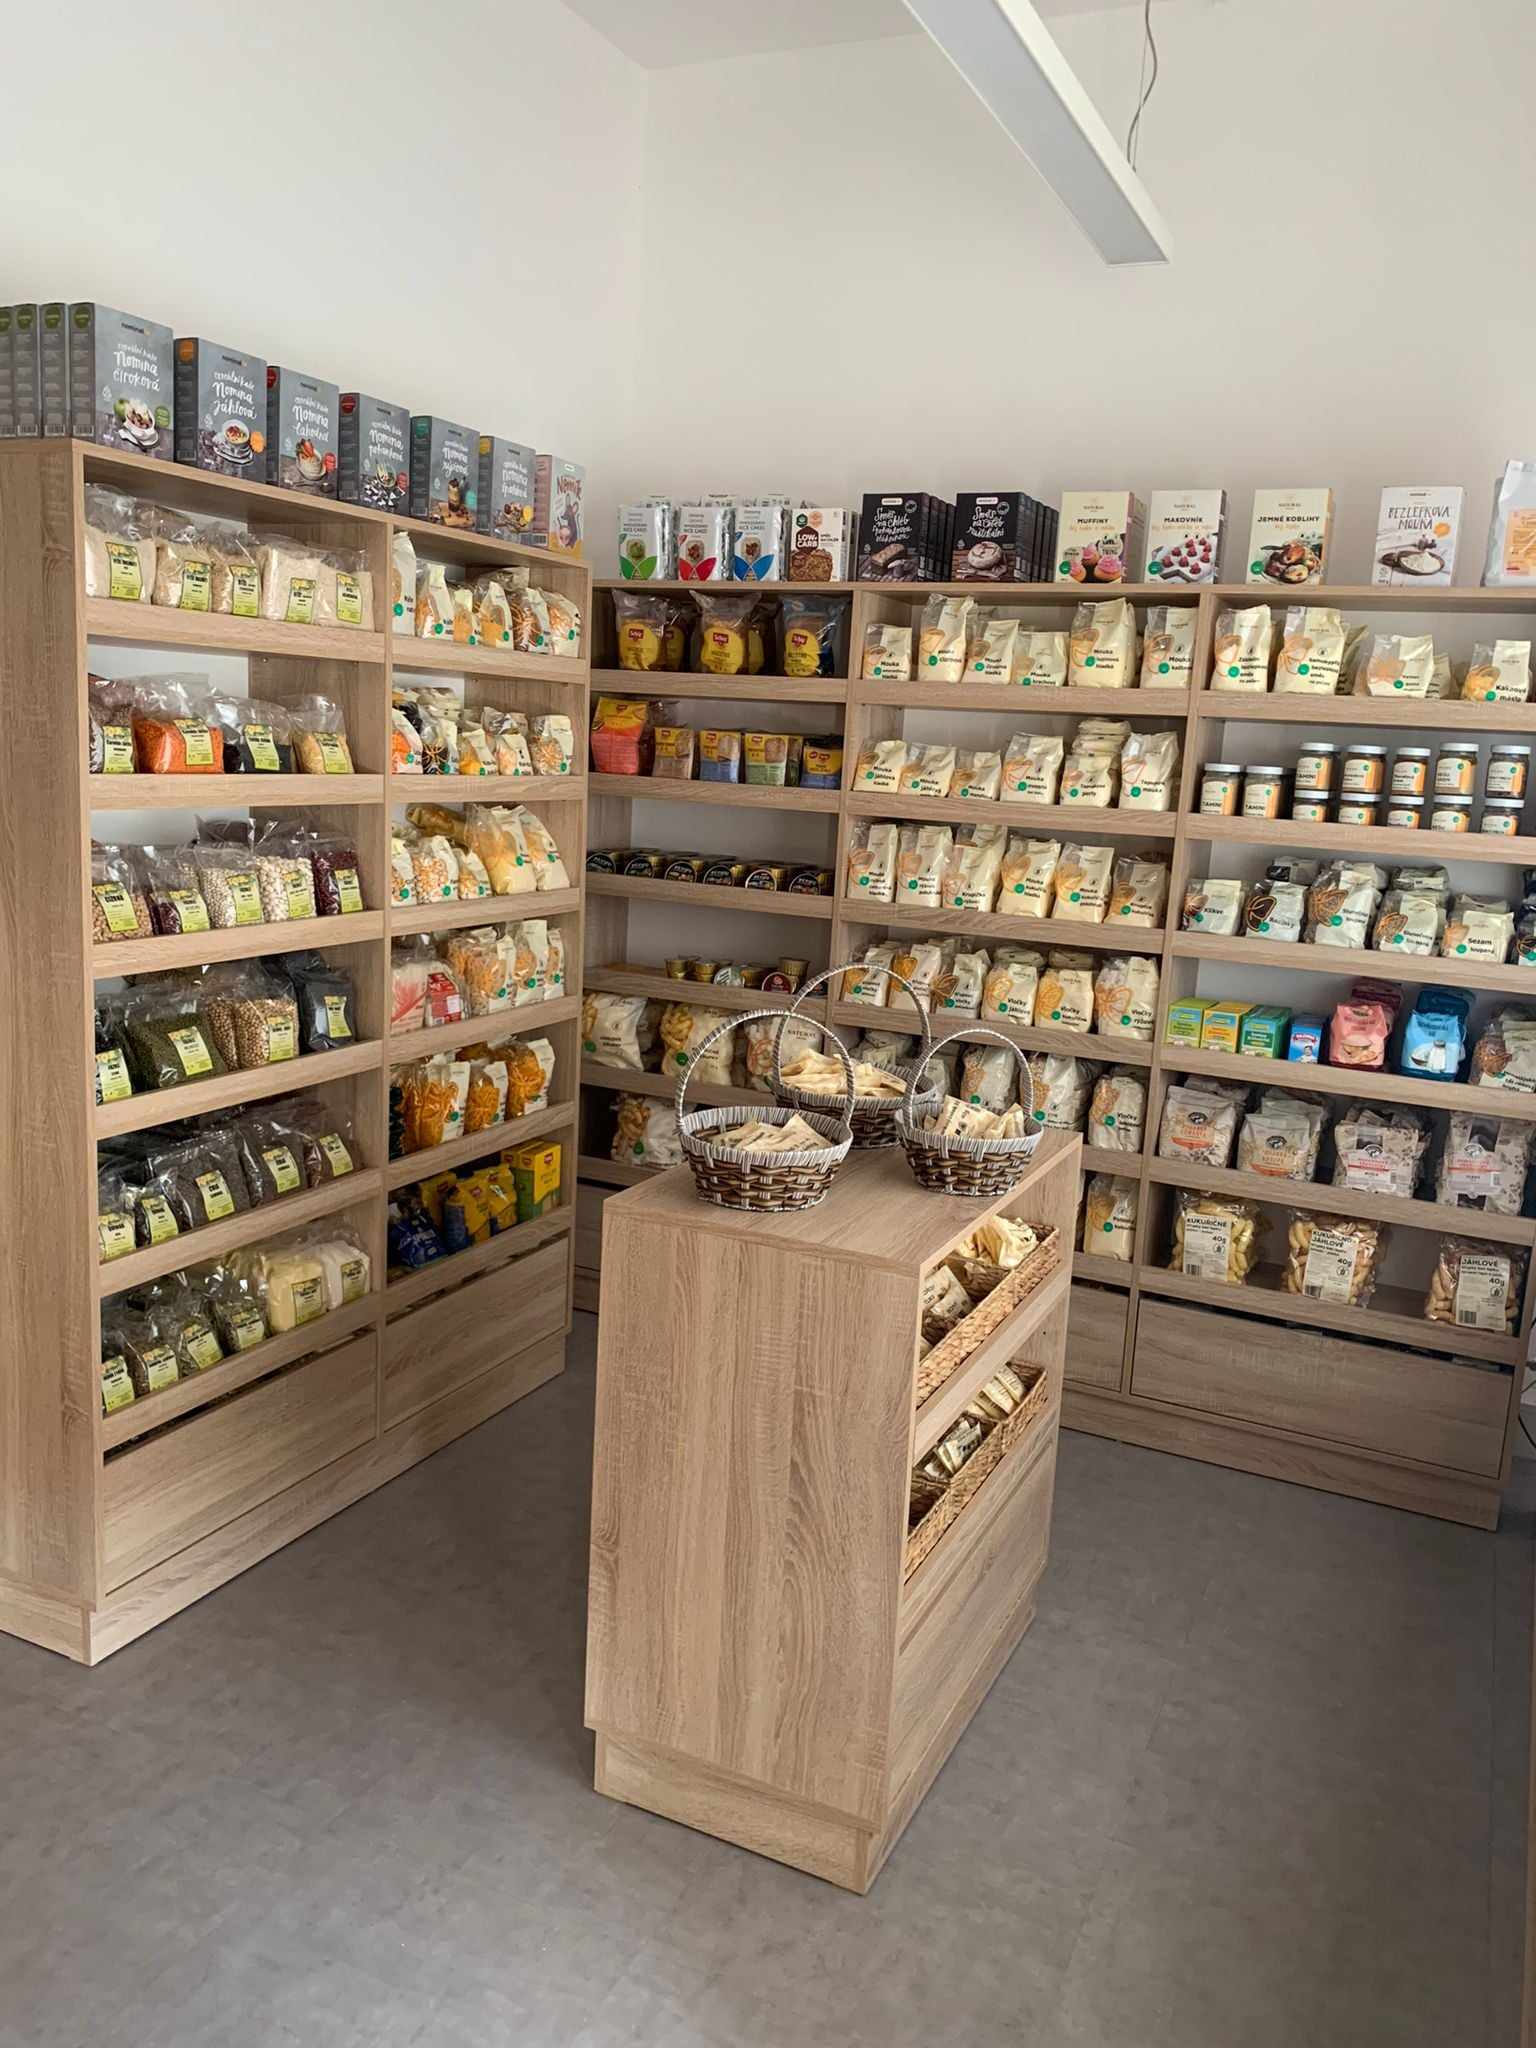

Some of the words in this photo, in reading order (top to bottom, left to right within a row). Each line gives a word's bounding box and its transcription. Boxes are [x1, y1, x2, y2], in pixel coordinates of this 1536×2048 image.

[114, 350, 160, 376] Nomina
[212, 382, 254, 405] Nomina
[292, 405, 329, 429] Nomina
[1164, 516, 1203, 524] MAKOVNÍK
[1398, 518, 1433, 530] MOUKA
[1468, 937, 1492, 945] Sezam
[1186, 1217, 1228, 1228] KUKUŘIČNÉ
[1212, 1234, 1227, 1245] 40g
[1311, 1237, 1344, 1248] JÁHLOVÉ
[1337, 1257, 1352, 1268] 40g
[1462, 1258, 1498, 1267] JÁHLOVÉ
[1488, 1277, 1505, 1287] 40g
